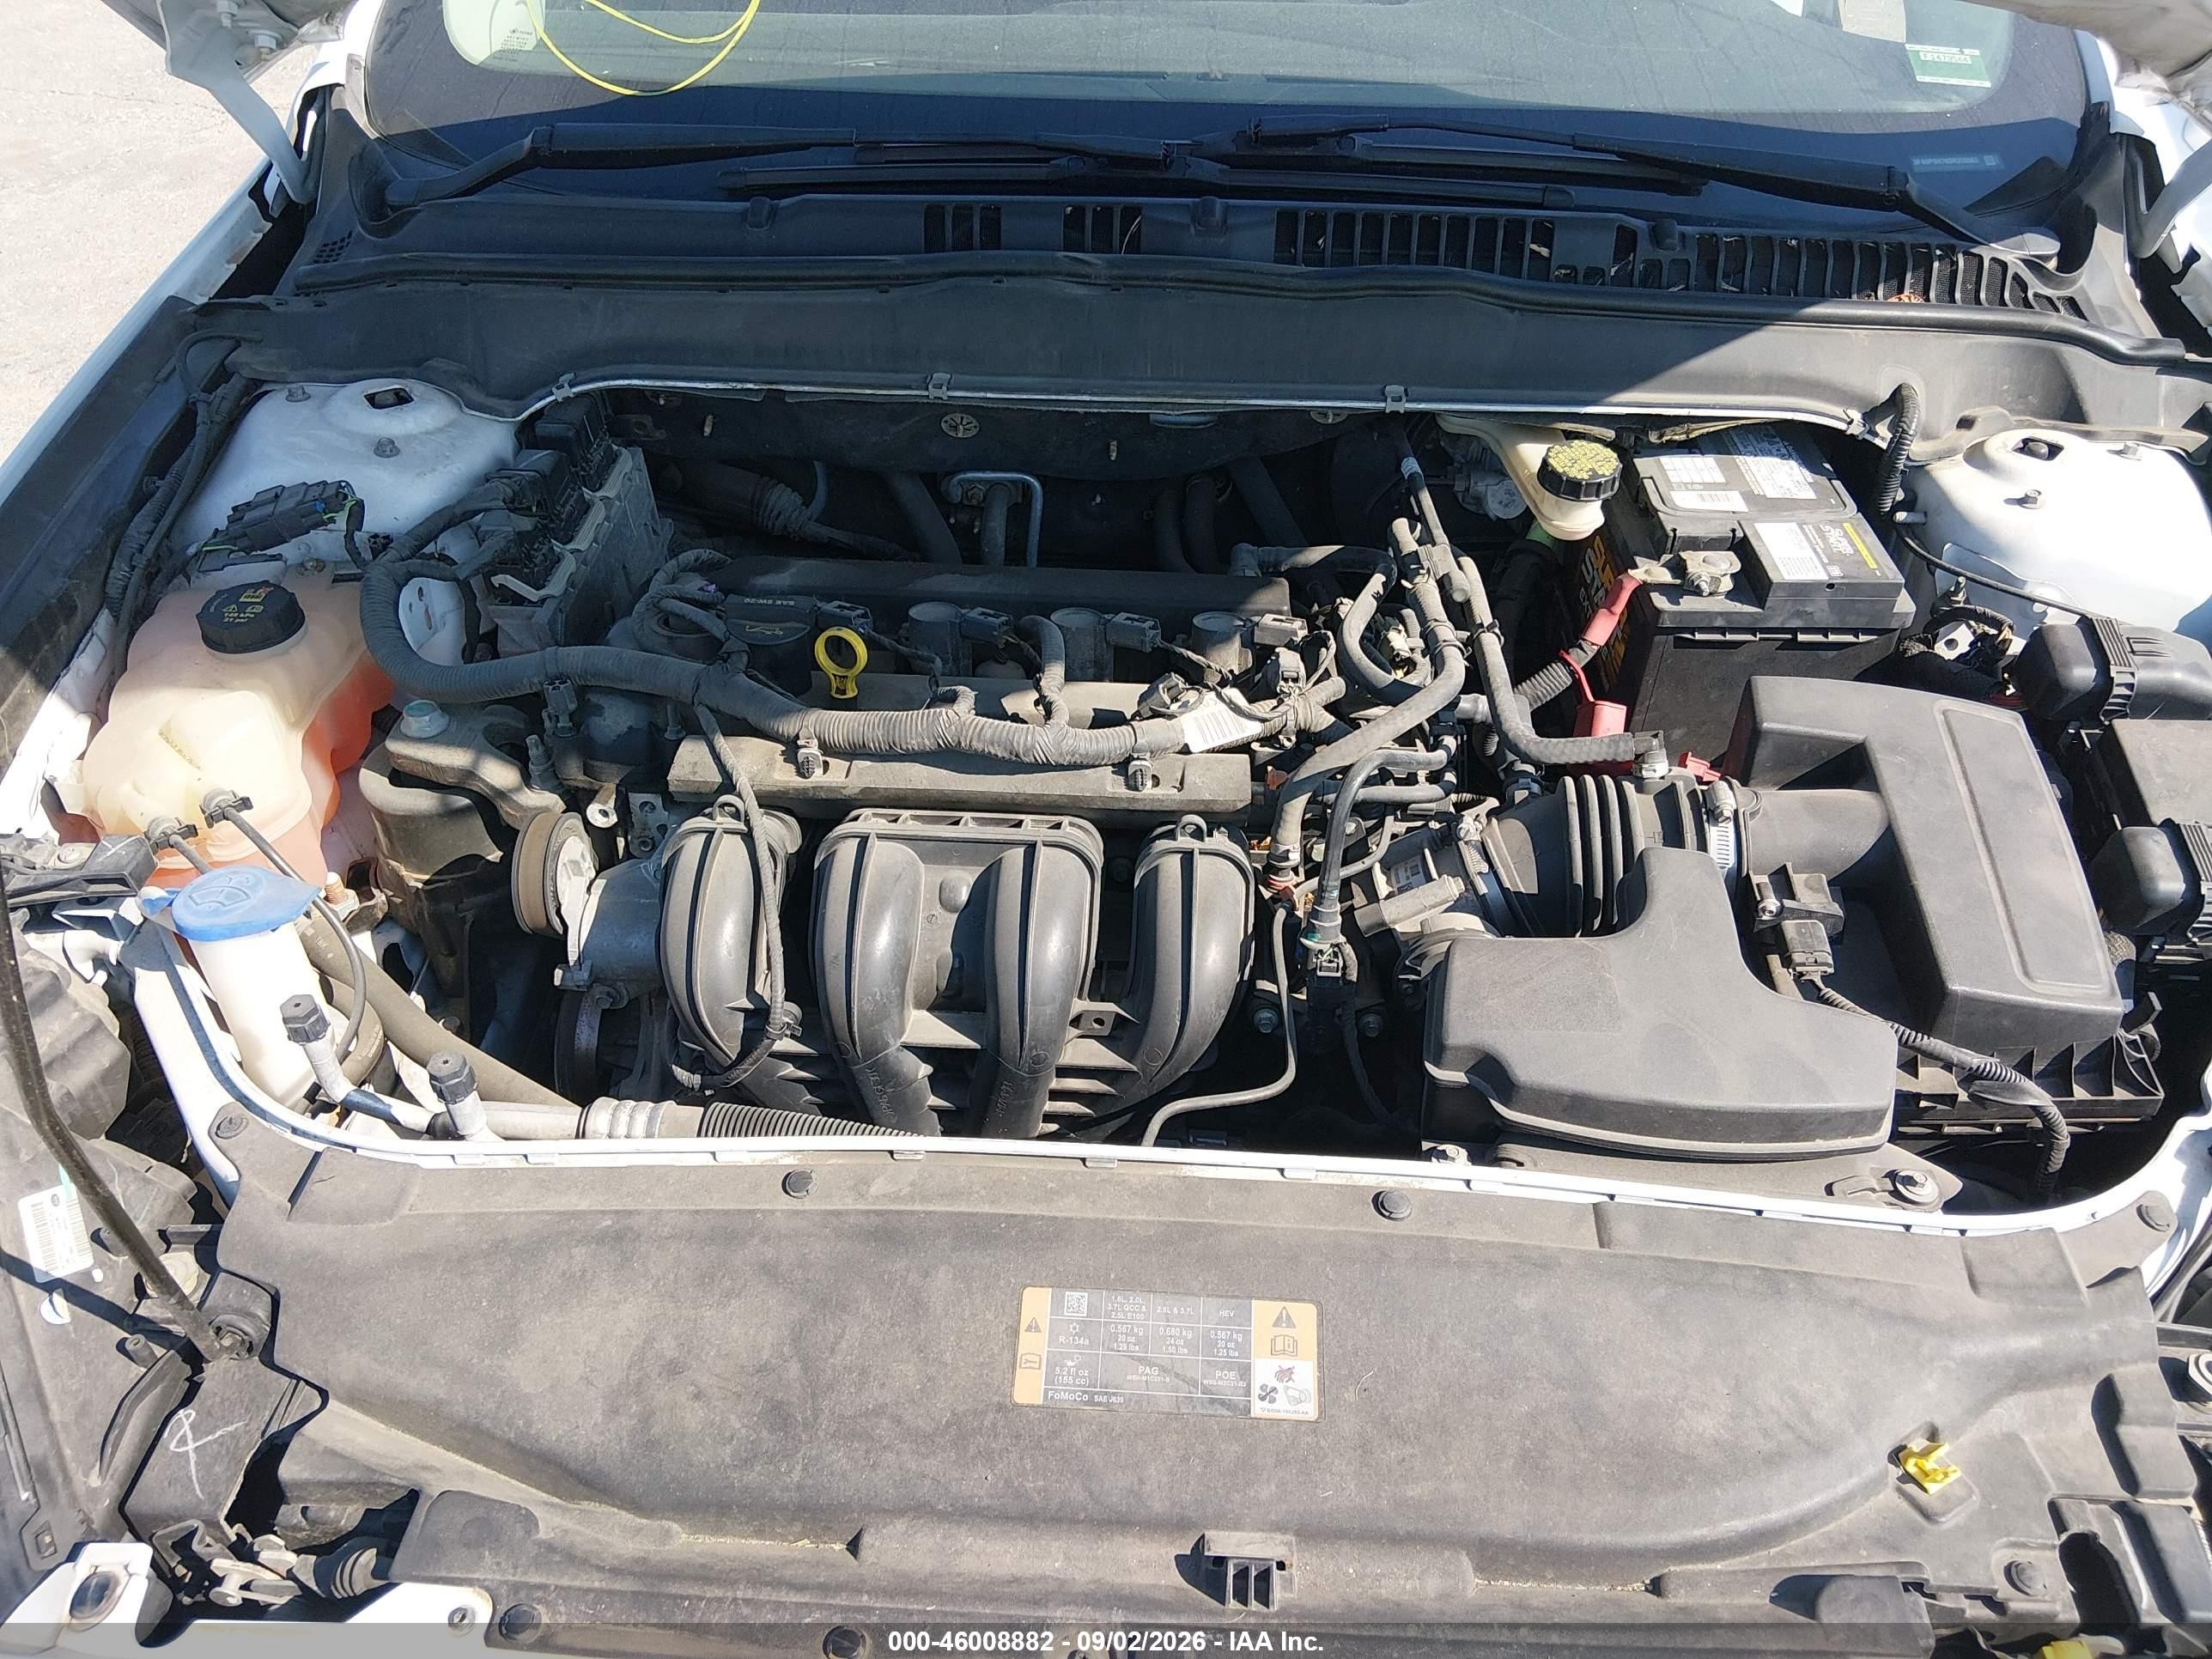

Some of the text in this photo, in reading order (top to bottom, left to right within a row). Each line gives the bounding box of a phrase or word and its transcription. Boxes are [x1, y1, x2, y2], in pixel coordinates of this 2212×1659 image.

[1110, 1324, 1144, 1336] 0.567 kg
[1159, 1327, 1193, 1339] 0.680 kg
[1059, 1335, 1090, 1346] R-134a
[1232, 1331, 1243, 1342] kg
[1054, 1366, 1068, 1375] 5.2
[1139, 1366, 1159, 1375] PAG
[1215, 1370, 1237, 1380] POE
[1054, 1376, 1089, 1387] (155 cc)
[1048, 1390, 1089, 1401] FoMoCo
